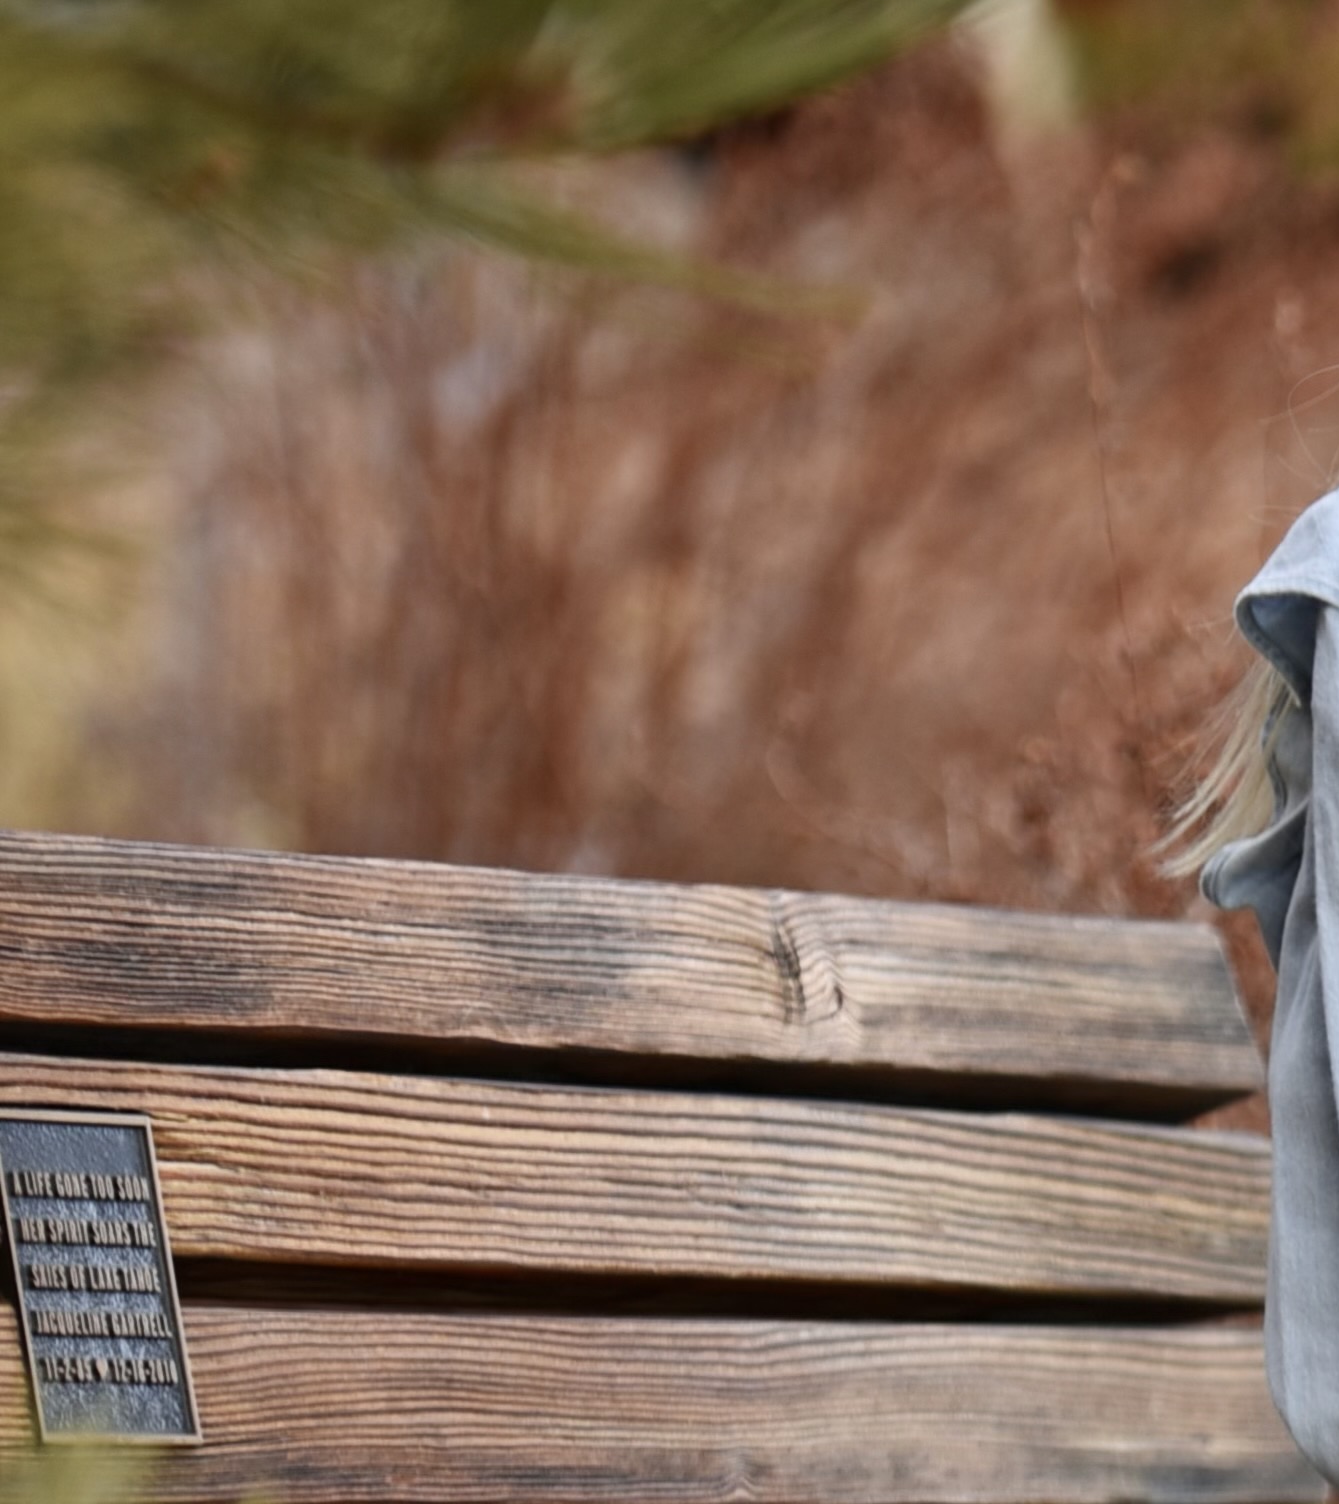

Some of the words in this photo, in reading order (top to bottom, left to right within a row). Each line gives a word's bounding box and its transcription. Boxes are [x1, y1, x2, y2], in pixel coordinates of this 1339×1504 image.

[13, 1171, 23, 1196] A
[25, 1171, 53, 1197] LIFE
[55, 1172, 89, 1198] GONE
[90, 1173, 115, 1200] TOO
[117, 1174, 150, 1201] SOON
[20, 1218, 46, 1243] HER
[48, 1218, 90, 1245] SPIRIT
[92, 1219, 132, 1246] SOARS
[132, 1221, 157, 1247] THE
[32, 1263, 67, 1289] SKIES
[70, 1264, 86, 1290] OF
[89, 1264, 121, 1290] LAKE
[122, 1265, 161, 1293] TAHOE
[37, 1311, 110, 1337] JACQUELINE
[111, 1311, 173, 1338] GARTRELL
